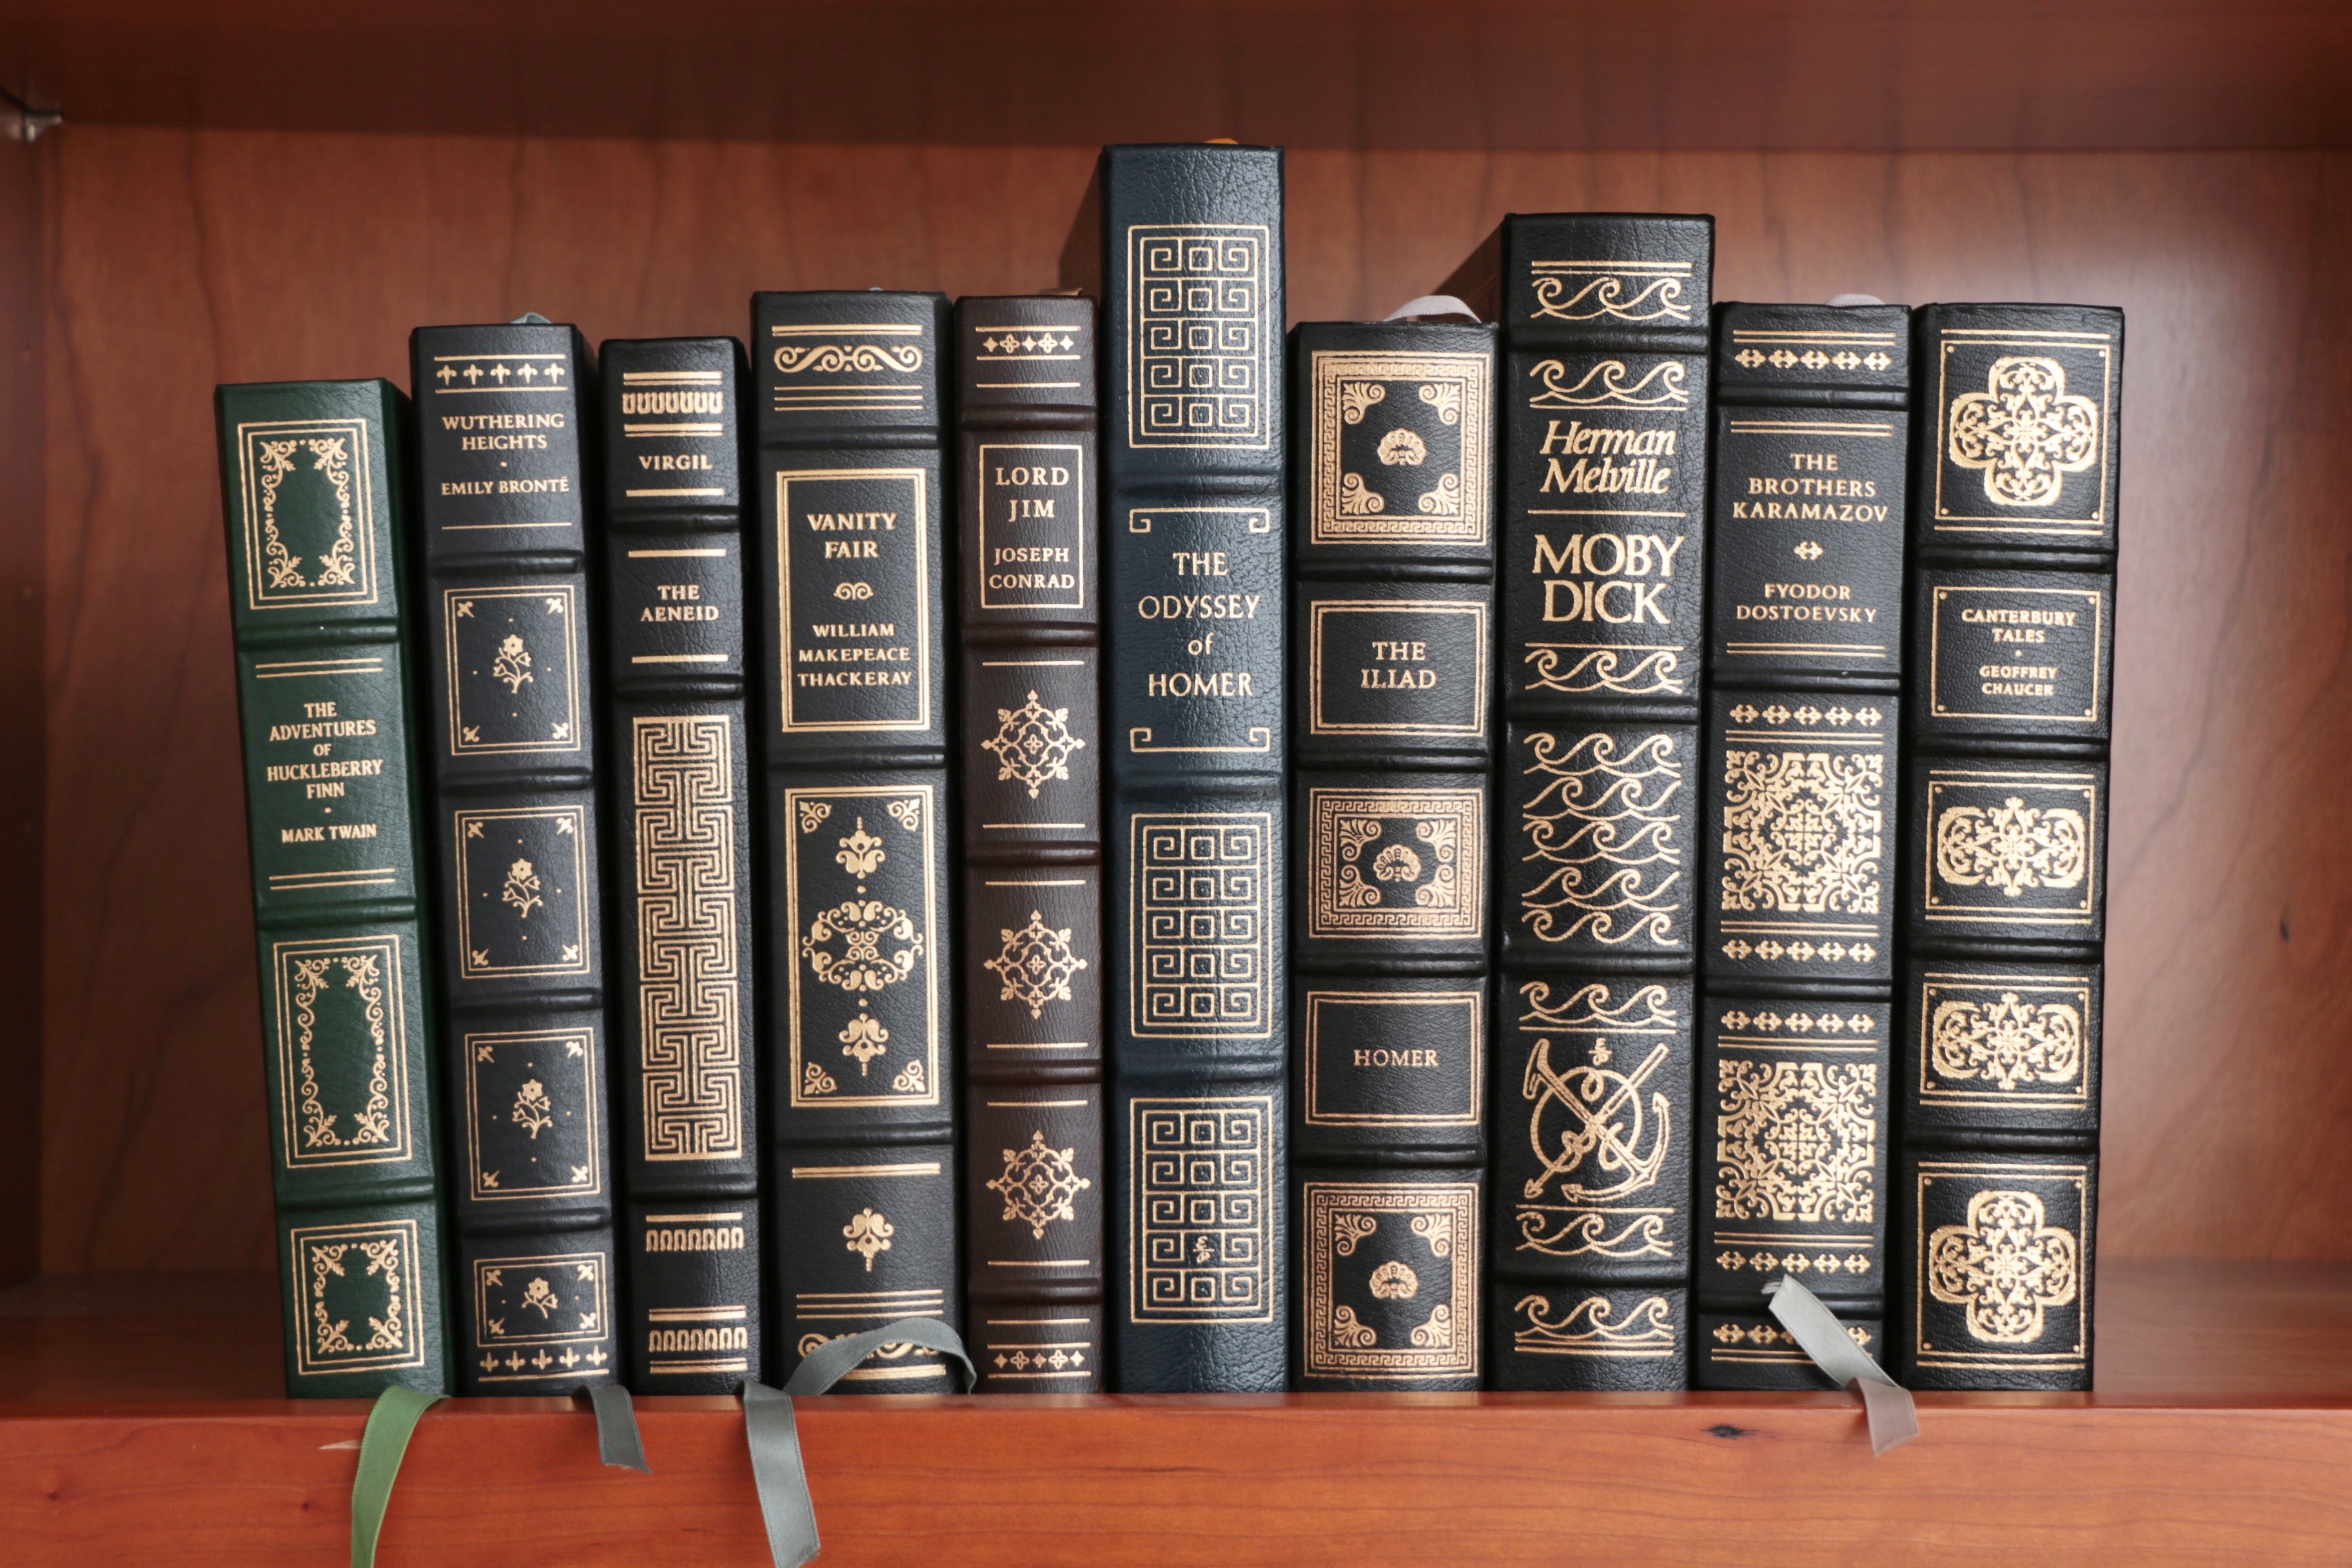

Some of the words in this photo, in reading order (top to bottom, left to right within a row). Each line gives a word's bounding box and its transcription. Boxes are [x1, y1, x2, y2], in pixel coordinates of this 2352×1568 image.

[442, 413, 565, 430] WUTHERING
[462, 435, 548, 450] HEIGHTS
[1539, 419, 1676, 455] Herman
[639, 456, 712, 470] VIRGIL
[1790, 453, 1838, 471] THE
[995, 467, 1070, 486] LORD
[1540, 458, 1671, 495] Melville
[442, 481, 494, 495] EMILY
[499, 477, 570, 493] BRONTË
[1748, 478, 1876, 496] BROTHERS
[1008, 499, 1055, 522] JIM
[1732, 502, 1888, 523] KARAMAZOV
[807, 512, 897, 531] VANITY
[825, 540, 879, 559] FAIR
[994, 547, 1070, 565] JOSEPH
[1532, 534, 1685, 576] MOBY
[1172, 552, 1229, 576] THE
[989, 573, 1075, 589] CONRAD
[657, 584, 700, 600] THE
[1765, 583, 1851, 600] FYODOR
[1138, 595, 1260, 620] ODYSSEY
[1542, 581, 1671, 624] DICK
[641, 606, 719, 622] AENEID
[1737, 605, 1877, 624] DOSTOEVSKY
[1961, 609, 2076, 627] CANTERBURY
[812, 623, 895, 637] WILLIAM
[1992, 627, 2045, 644] TALES
[1188, 632, 1215, 656] of
[1372, 641, 1427, 661] THE
[799, 646, 912, 663] MAKEPEACE
[797, 672, 913, 687] THACKERAY
[1360, 669, 1438, 689] ILIAD
[1979, 665, 2057, 680] GEOFFREY
[1149, 673, 1253, 697] HOMER
[1981, 682, 2054, 697] CHAUCER
[304, 701, 337, 718] THE
[270, 721, 377, 741] ADVENTURES
[313, 743, 332, 756] OF
[267, 758, 384, 781] HUCKLEBERRY
[306, 781, 345, 799] FINN
[281, 827, 325, 843] MARK
[328, 823, 377, 840] TWAIN
[1354, 1049, 1440, 1067] HOMER
